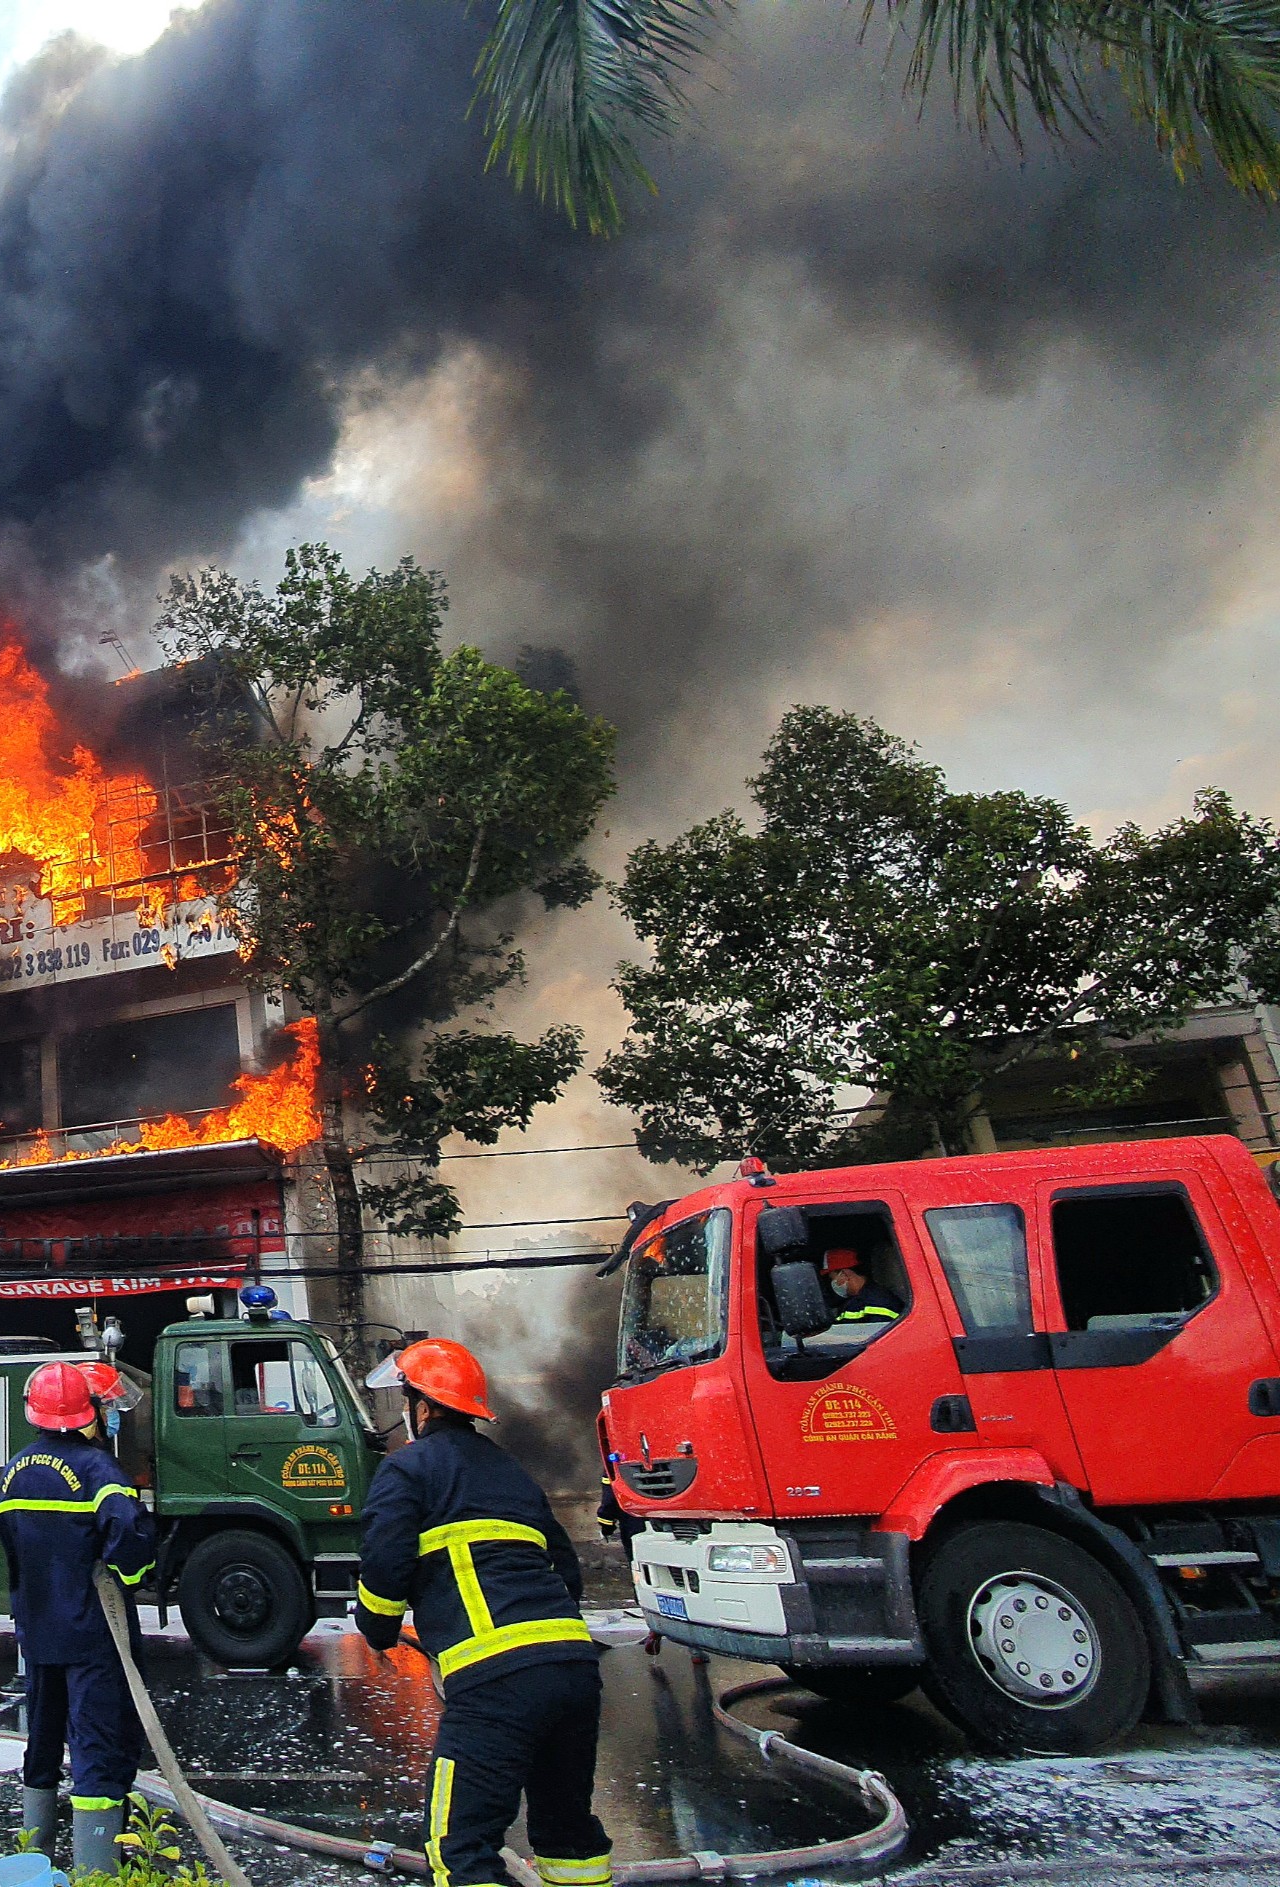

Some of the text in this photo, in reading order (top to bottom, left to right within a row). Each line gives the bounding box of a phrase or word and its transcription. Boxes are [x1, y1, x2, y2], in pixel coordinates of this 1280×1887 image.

[102, 938, 130, 962] Fax:
[842, 1399, 862, 1409] 114
[31, 1454, 52, 1465] PCCC
[51, 1457, 64, 1471] VÀ
[60, 1464, 82, 1492] CNCH
[312, 1463, 327, 1474] 114
